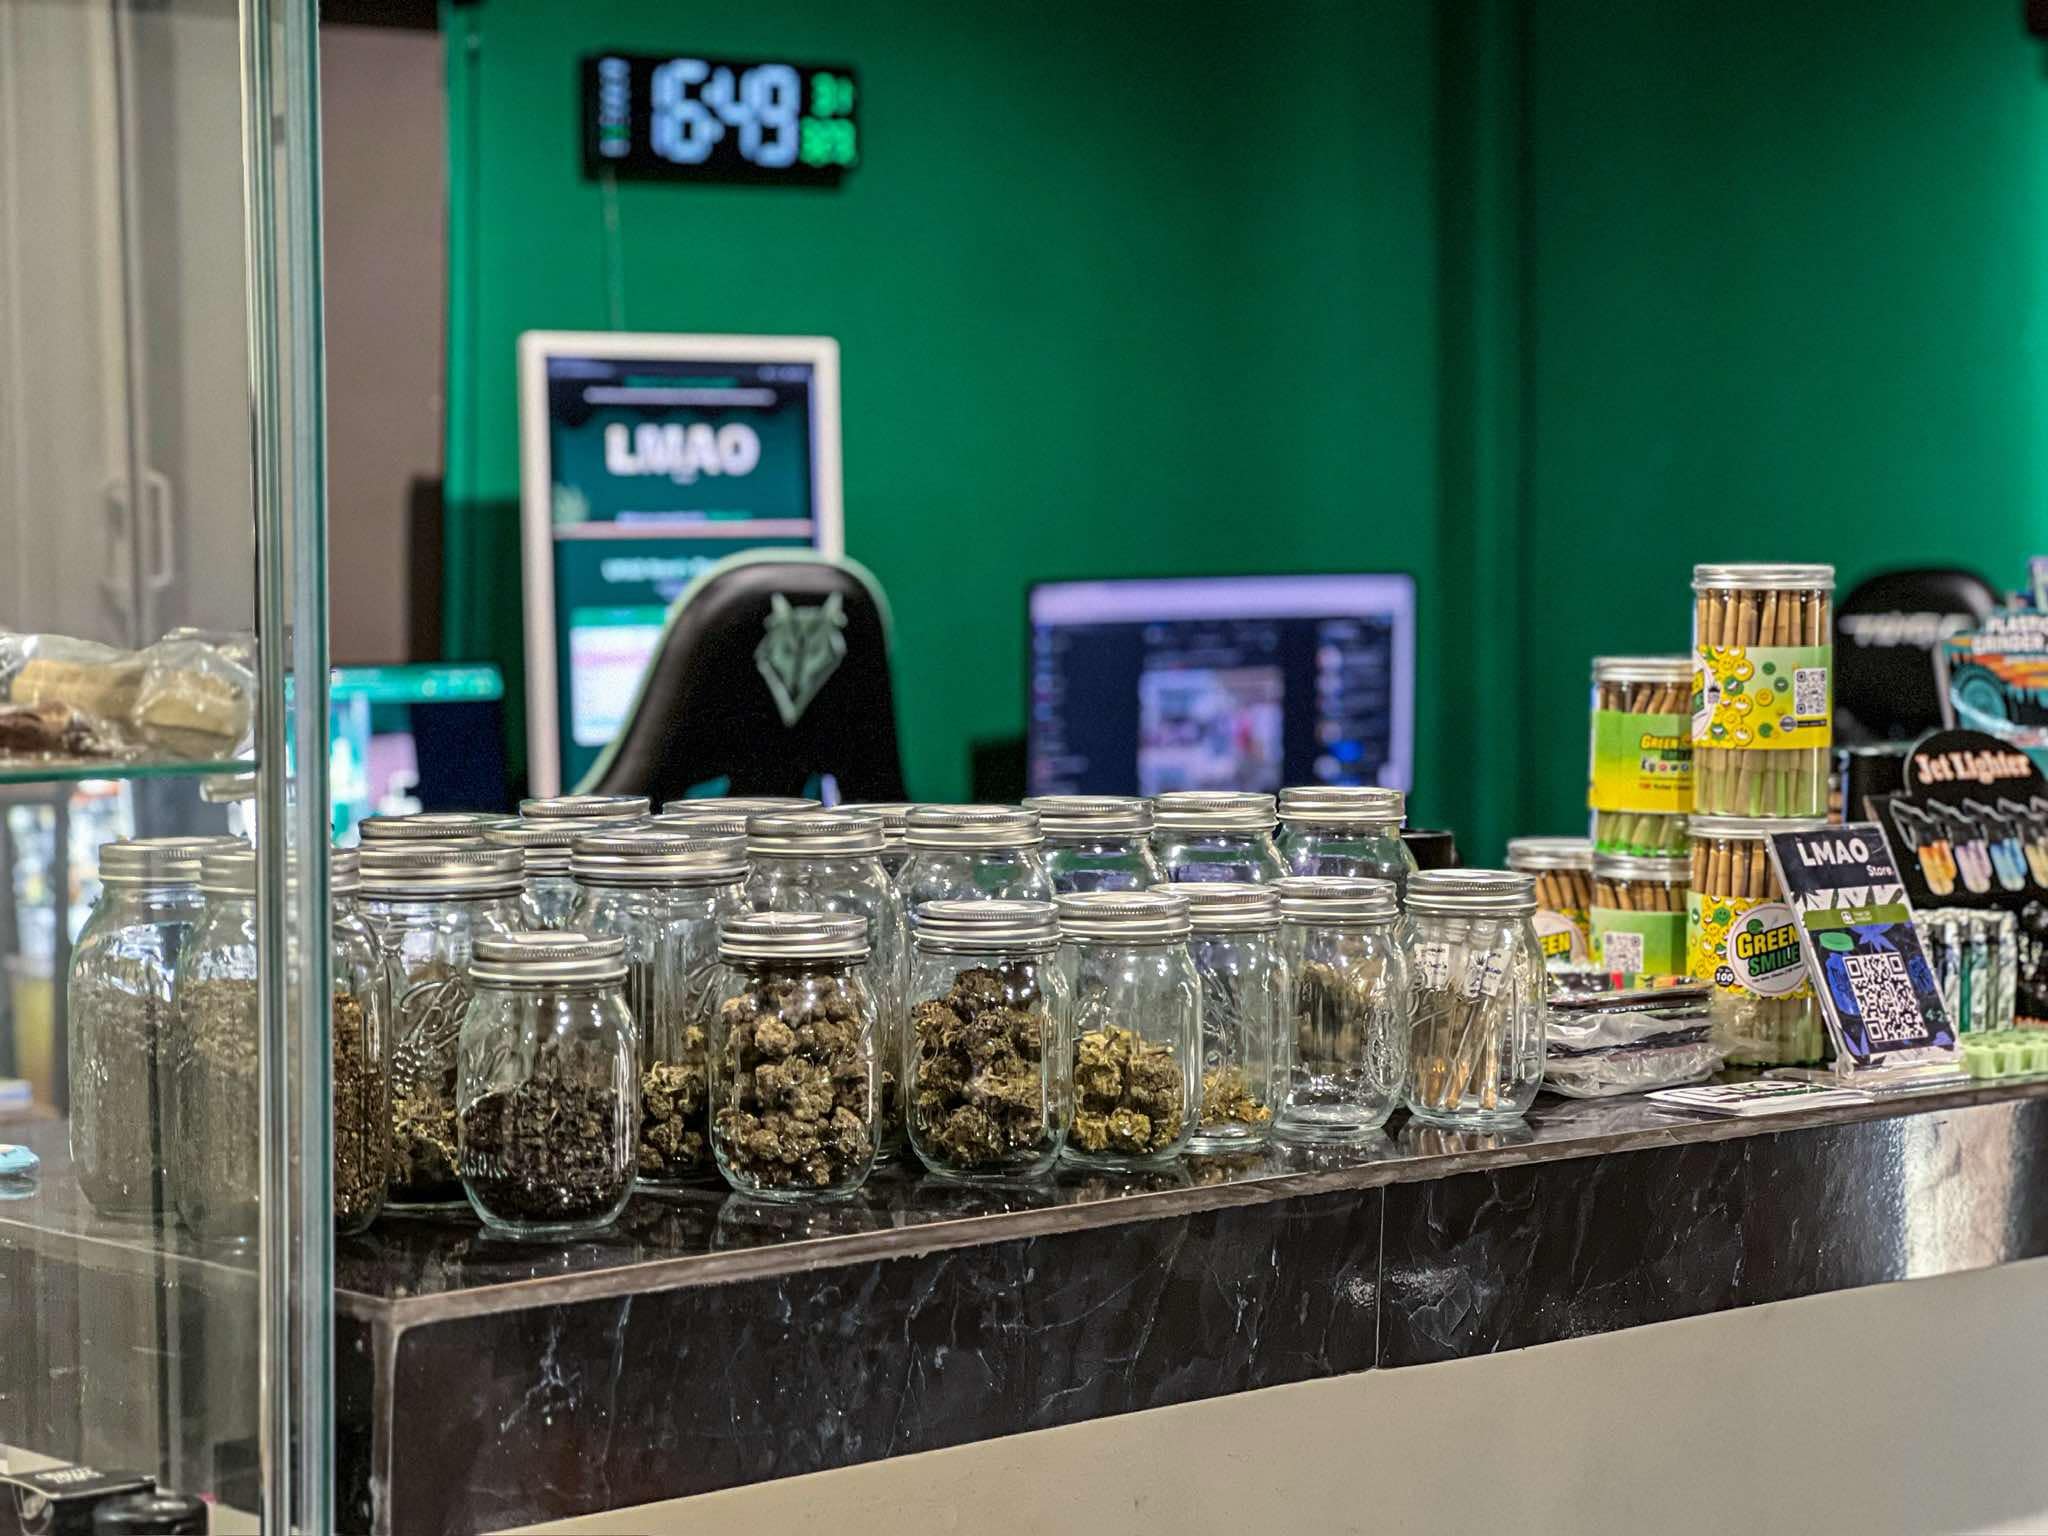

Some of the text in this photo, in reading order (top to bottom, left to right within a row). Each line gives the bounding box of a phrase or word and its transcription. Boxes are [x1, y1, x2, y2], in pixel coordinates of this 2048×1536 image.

[604, 422, 760, 475] LMAO
[1914, 750, 2032, 785] Jet Lighter
[1796, 837, 1870, 867] LMAO
[1736, 924, 1800, 960] GREEN
[1748, 942, 1801, 977] SMILE
[1716, 972, 1733, 982] 100
